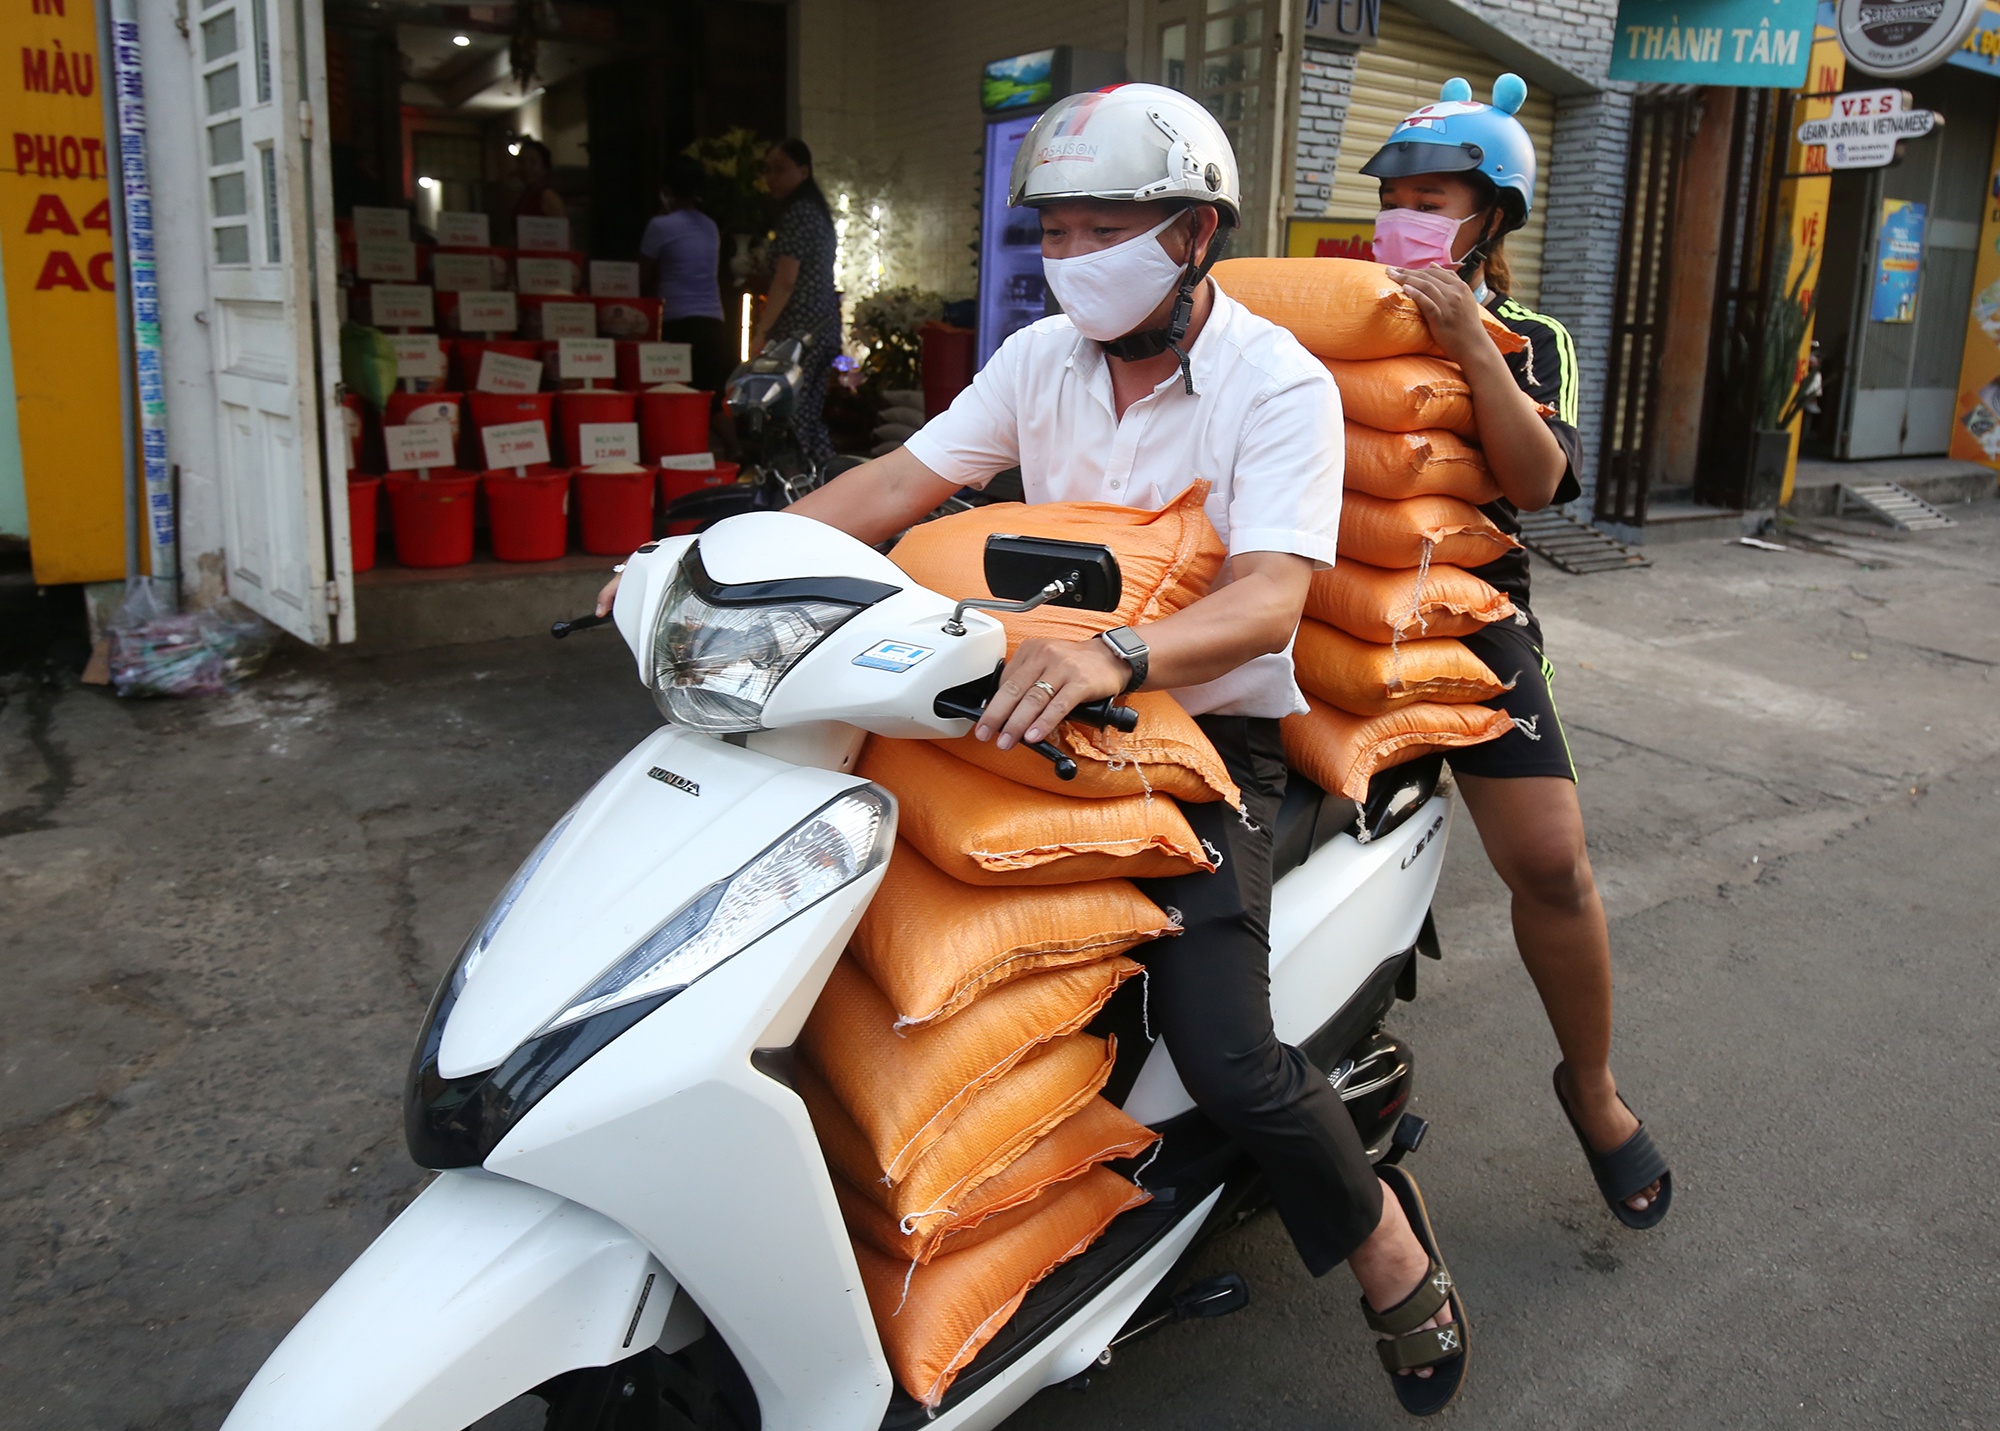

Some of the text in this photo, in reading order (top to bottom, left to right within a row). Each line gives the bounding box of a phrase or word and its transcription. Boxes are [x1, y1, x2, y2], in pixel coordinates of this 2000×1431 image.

[1626, 15, 1800, 66] THÀNH TÂM
[21, 38, 94, 98] MÀU
[1802, 113, 1930, 141] LEARN SURVIVAL VIETNAMESE
[13, 132, 107, 182] PHOT
[25, 194, 112, 238] A4
[646, 765, 701, 797] HONDA
